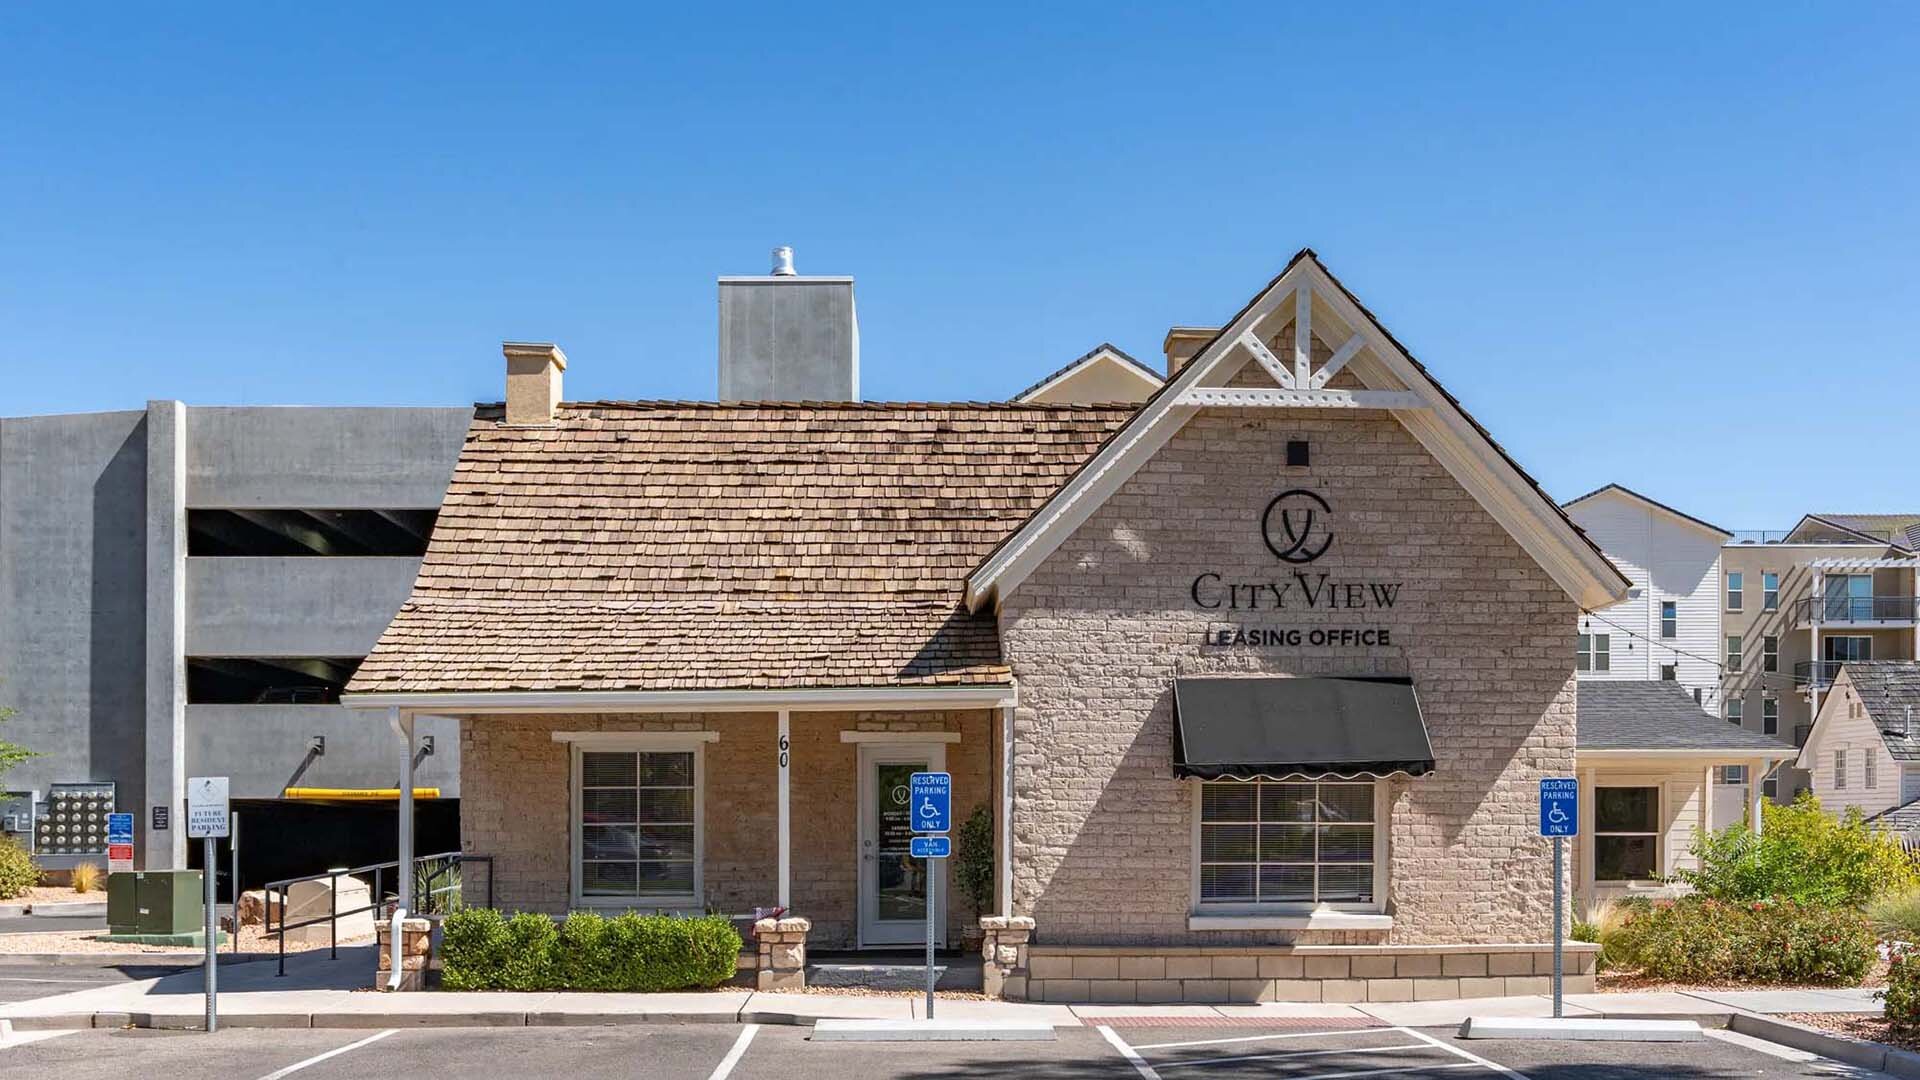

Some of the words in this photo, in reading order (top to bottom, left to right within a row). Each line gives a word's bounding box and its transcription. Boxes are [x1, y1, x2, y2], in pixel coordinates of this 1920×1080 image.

[1205, 629, 1301, 646] LEASING
[1309, 629, 1390, 646] OFFICE
[779, 735, 789, 768] 60
[912, 776, 948, 784] RESERVED
[1541, 781, 1577, 789] RESERVED
